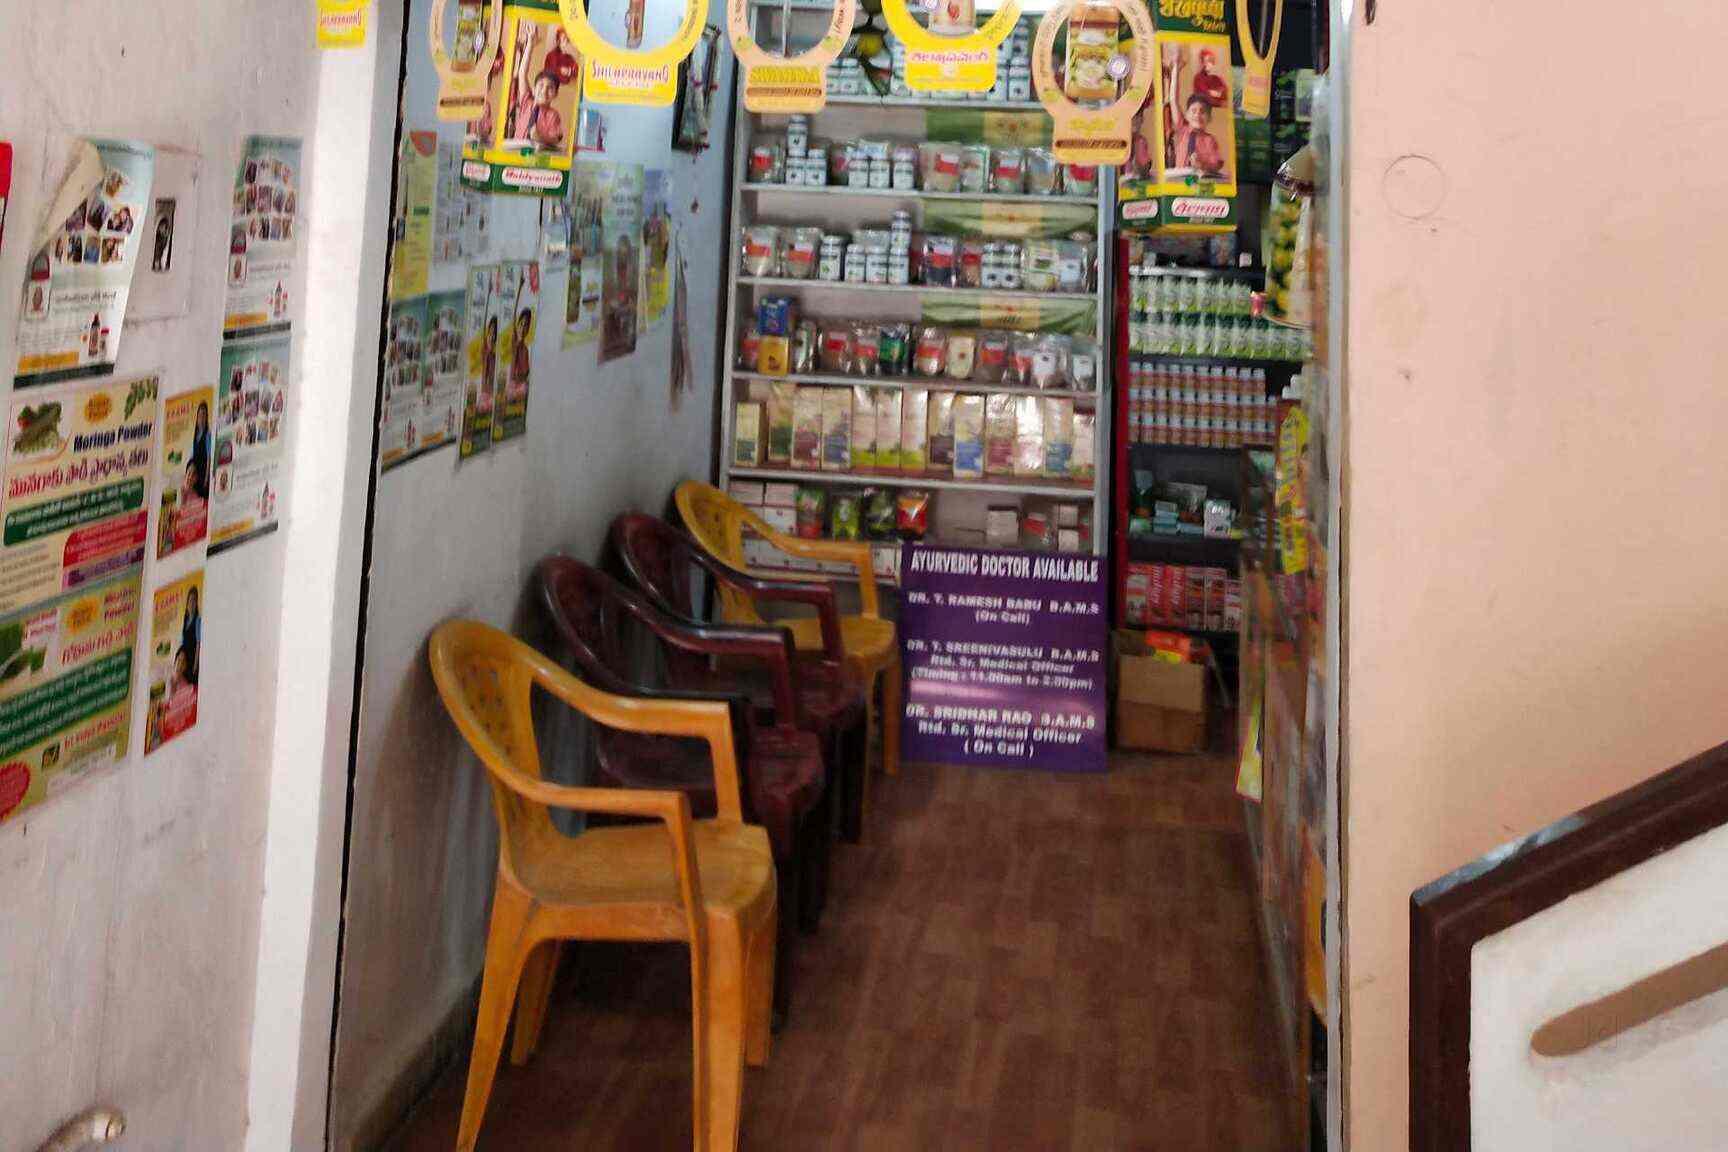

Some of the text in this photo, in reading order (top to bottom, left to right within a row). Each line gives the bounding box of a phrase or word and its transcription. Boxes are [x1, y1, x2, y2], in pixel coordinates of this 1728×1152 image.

[910, 550, 1099, 583] AYURVEDIC DOCTOR AVAILABLE
